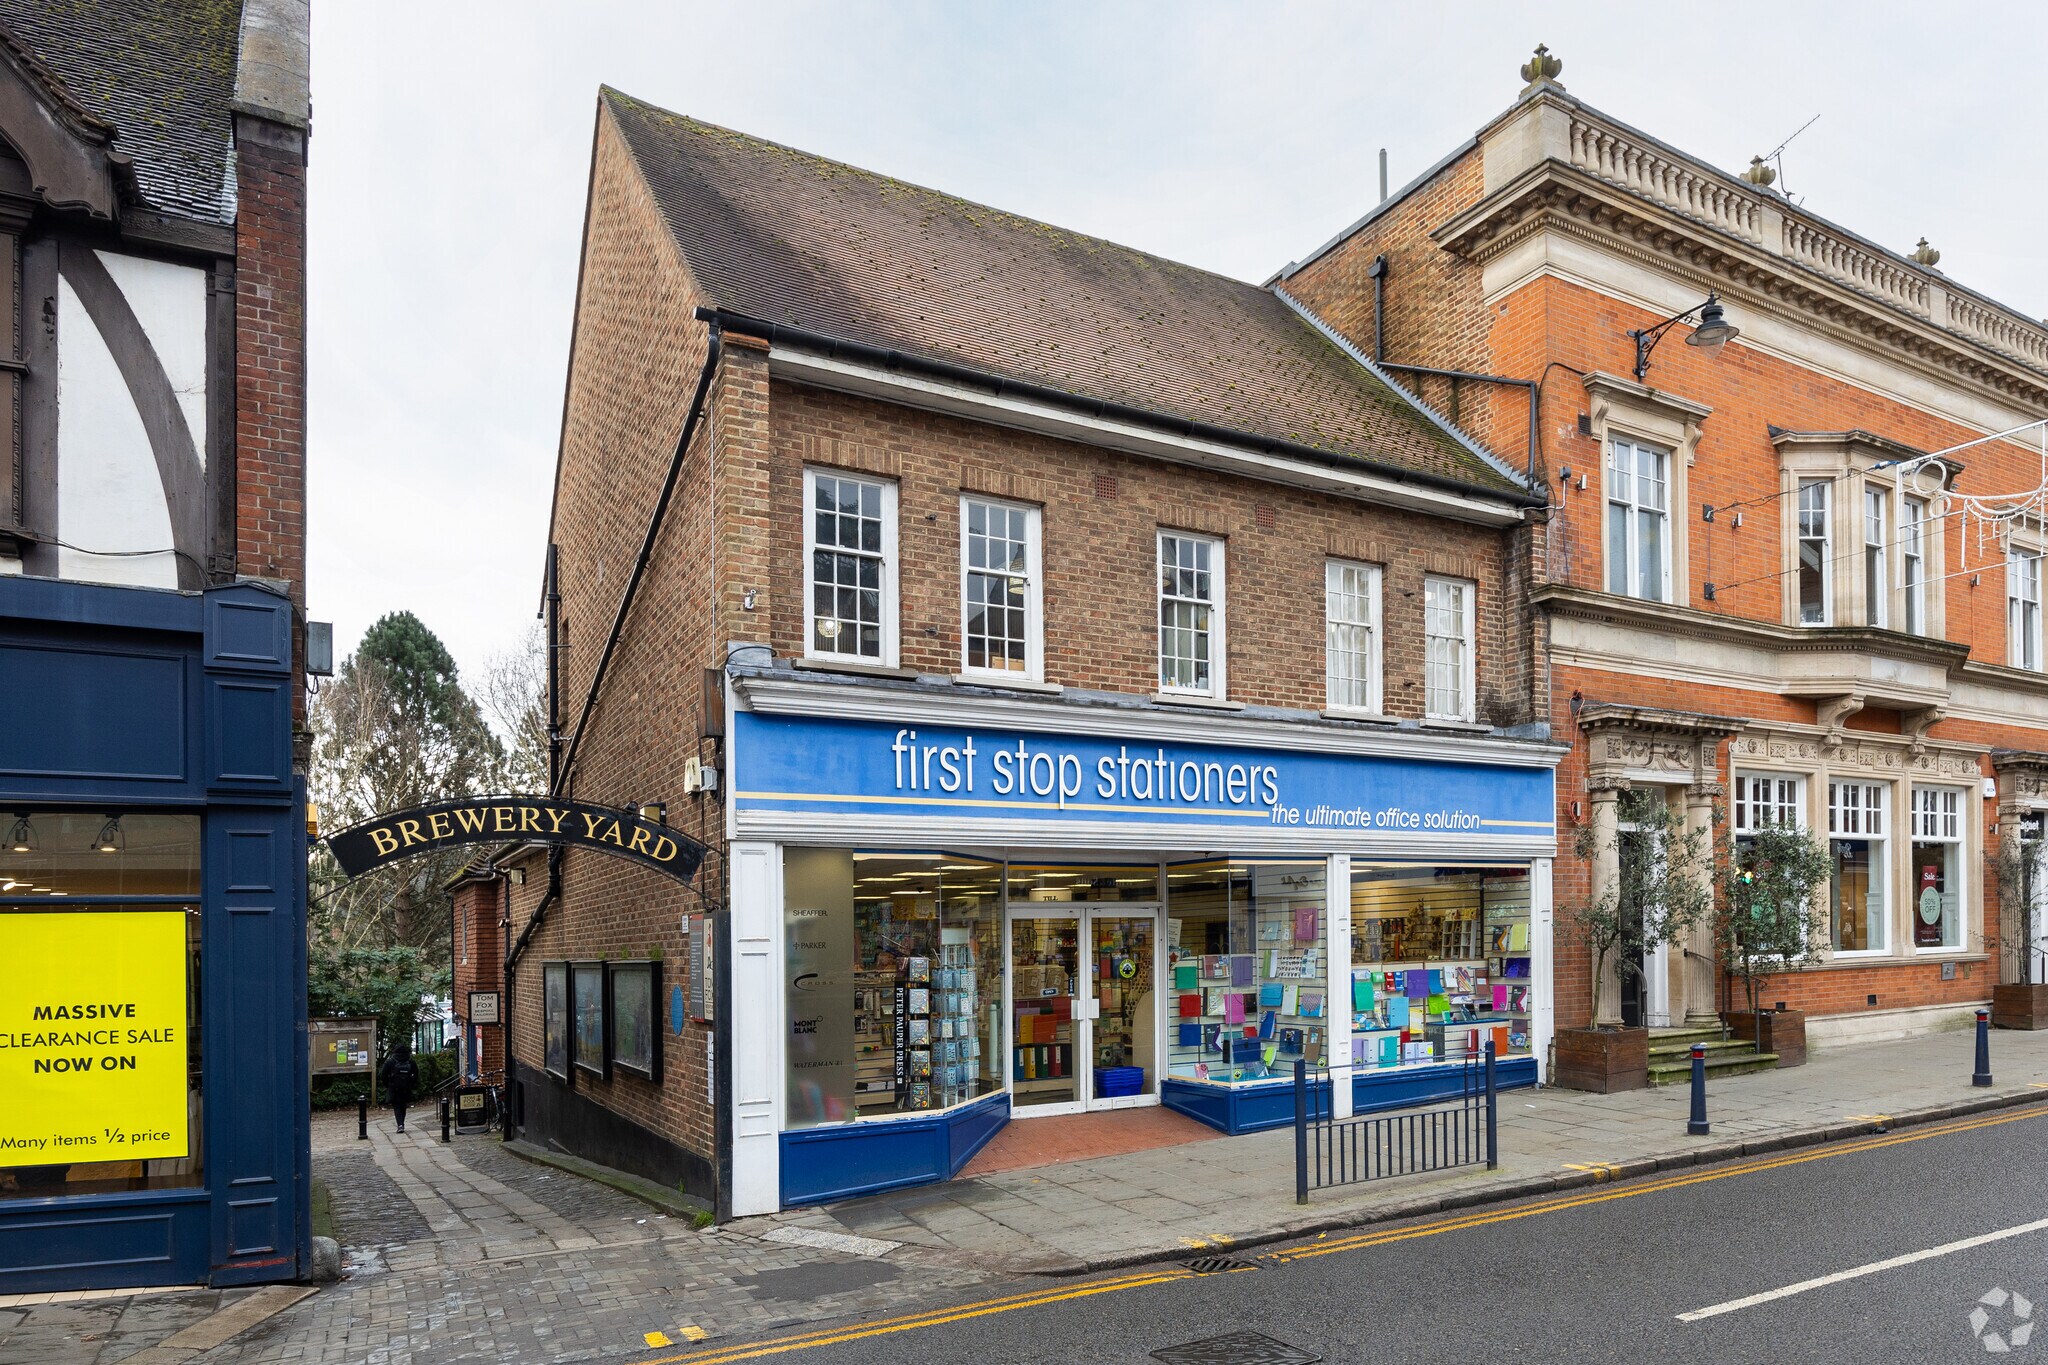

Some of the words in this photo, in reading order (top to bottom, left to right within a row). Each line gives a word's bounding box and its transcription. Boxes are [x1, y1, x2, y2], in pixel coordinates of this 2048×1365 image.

[892, 729, 976, 792] first
[992, 739, 1082, 810] stop
[1097, 745, 1279, 806] stationers
[1271, 803, 1300, 825] the
[1305, 804, 1371, 827] ultimate
[1375, 807, 1420, 829] office
[1423, 809, 1480, 830] solution
[367, 806, 571, 857] BREWERY
[580, 813, 678, 863] YARD
[1923, 872, 1936, 880] Sale
[1924, 905, 1936, 913] OFF
[896, 987, 904, 1015] PETER
[33, 1003, 136, 1021] MASSIVE
[0, 1030, 120, 1049] CLEARANCE
[127, 1028, 175, 1044] SALE
[896, 1016, 904, 1049] PAUPER
[34, 1057, 93, 1074] NOW
[100, 1055, 136, 1071] ON
[794, 1061, 834, 1069] WATERMAN
[896, 1050, 904, 1076] PRESS
[0, 1136, 47, 1150] Many
[53, 1134, 97, 1146] items
[131, 1129, 171, 1145] price
